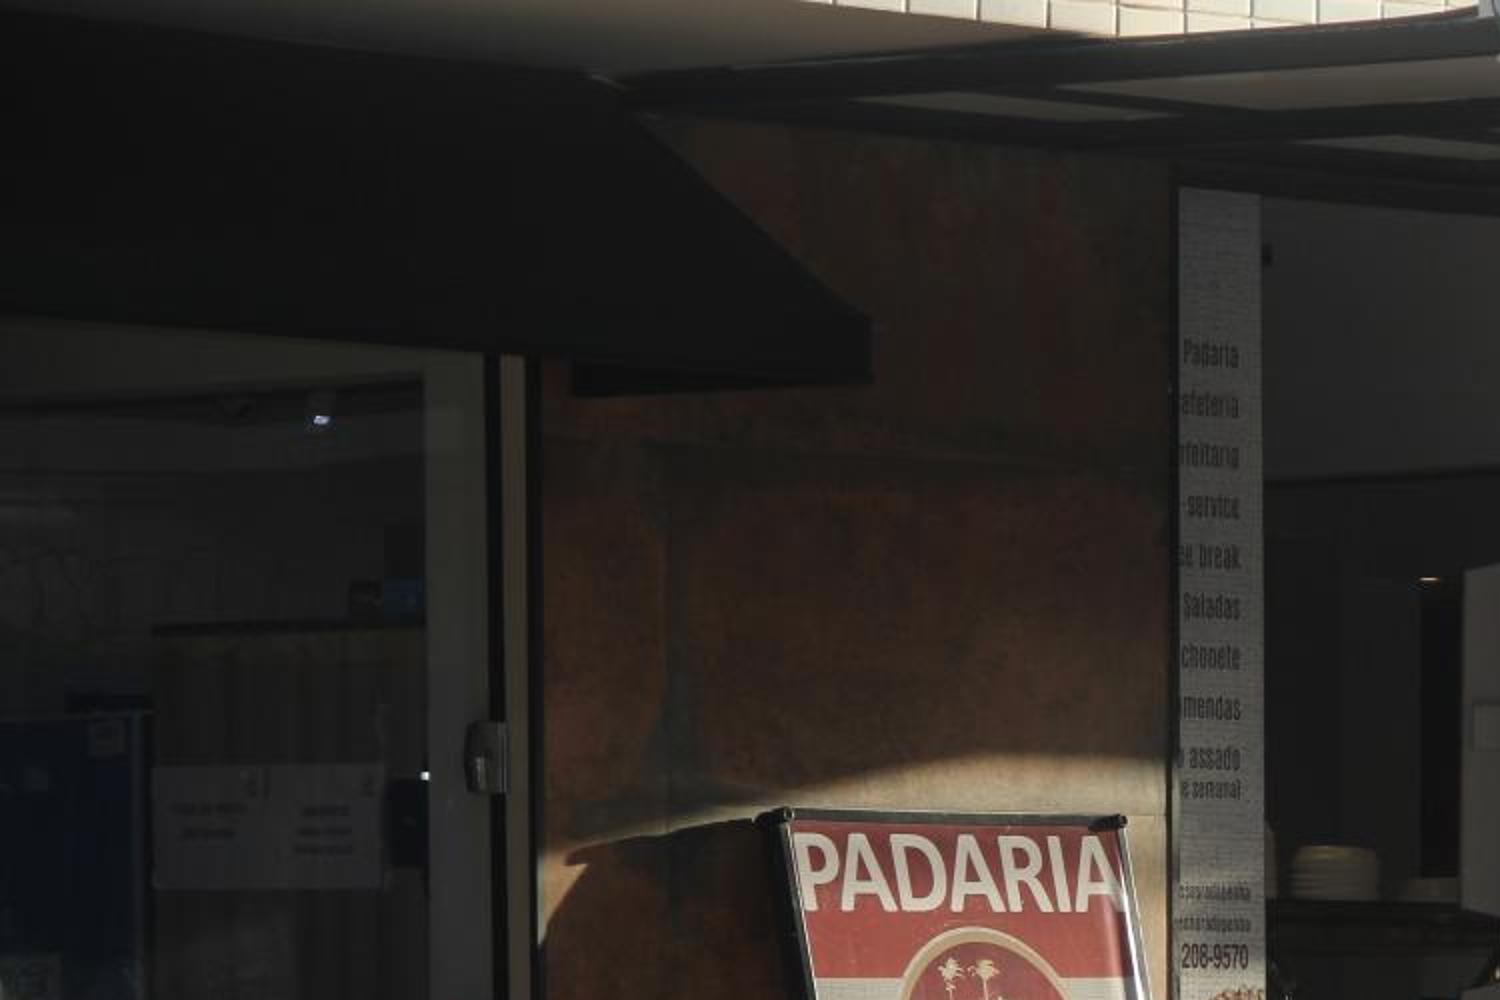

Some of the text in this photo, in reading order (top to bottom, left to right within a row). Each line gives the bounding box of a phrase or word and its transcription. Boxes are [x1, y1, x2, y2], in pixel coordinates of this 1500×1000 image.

[1183, 337, 1240, 369] Padaria
[1199, 543, 1241, 569] break
[1190, 747, 1240, 770] assado
[792, 831, 1127, 913] PADARIA
[1181, 943, 1249, 970] 208-9570
